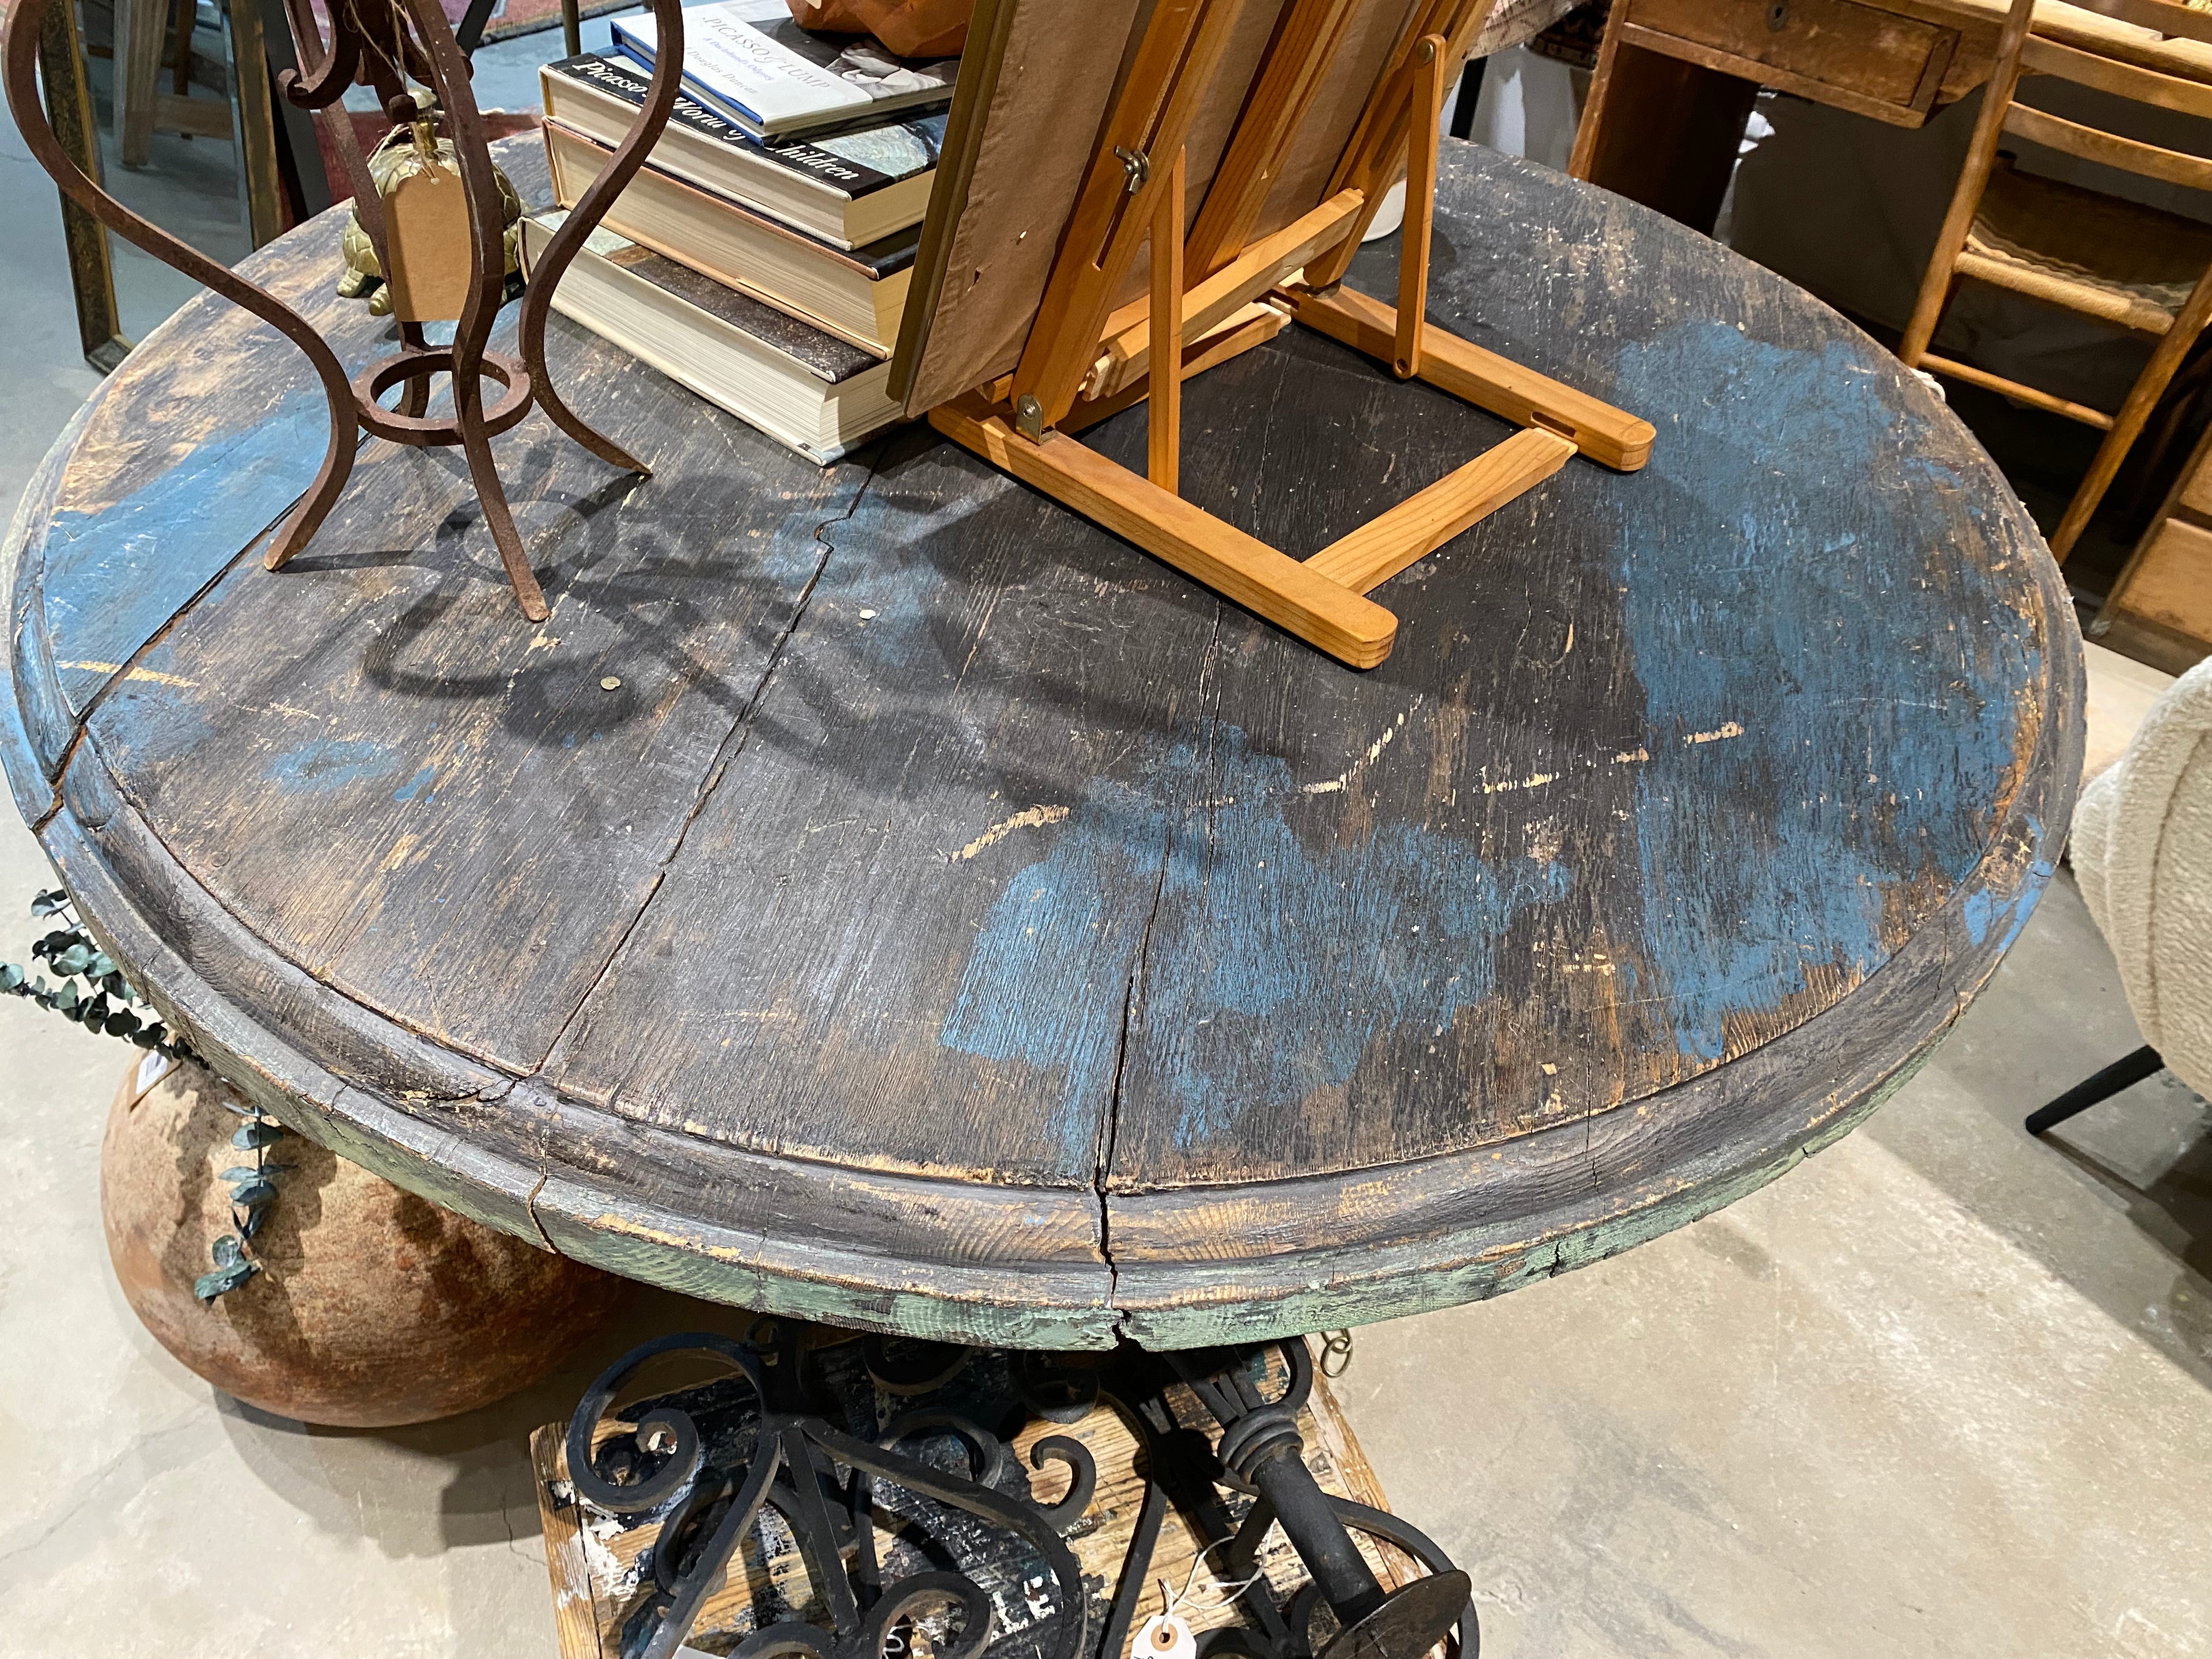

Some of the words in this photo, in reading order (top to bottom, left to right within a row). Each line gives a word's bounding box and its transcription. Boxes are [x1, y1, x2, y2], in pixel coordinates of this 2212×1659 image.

[687, 51, 724, 74] Douglas
[722, 73, 759, 94] Duncan
[703, 17, 770, 56] PICASSO
[777, 62, 830, 88] LUMP
[572, 60, 647, 98] Picasso
[763, 145, 859, 180] hildren
